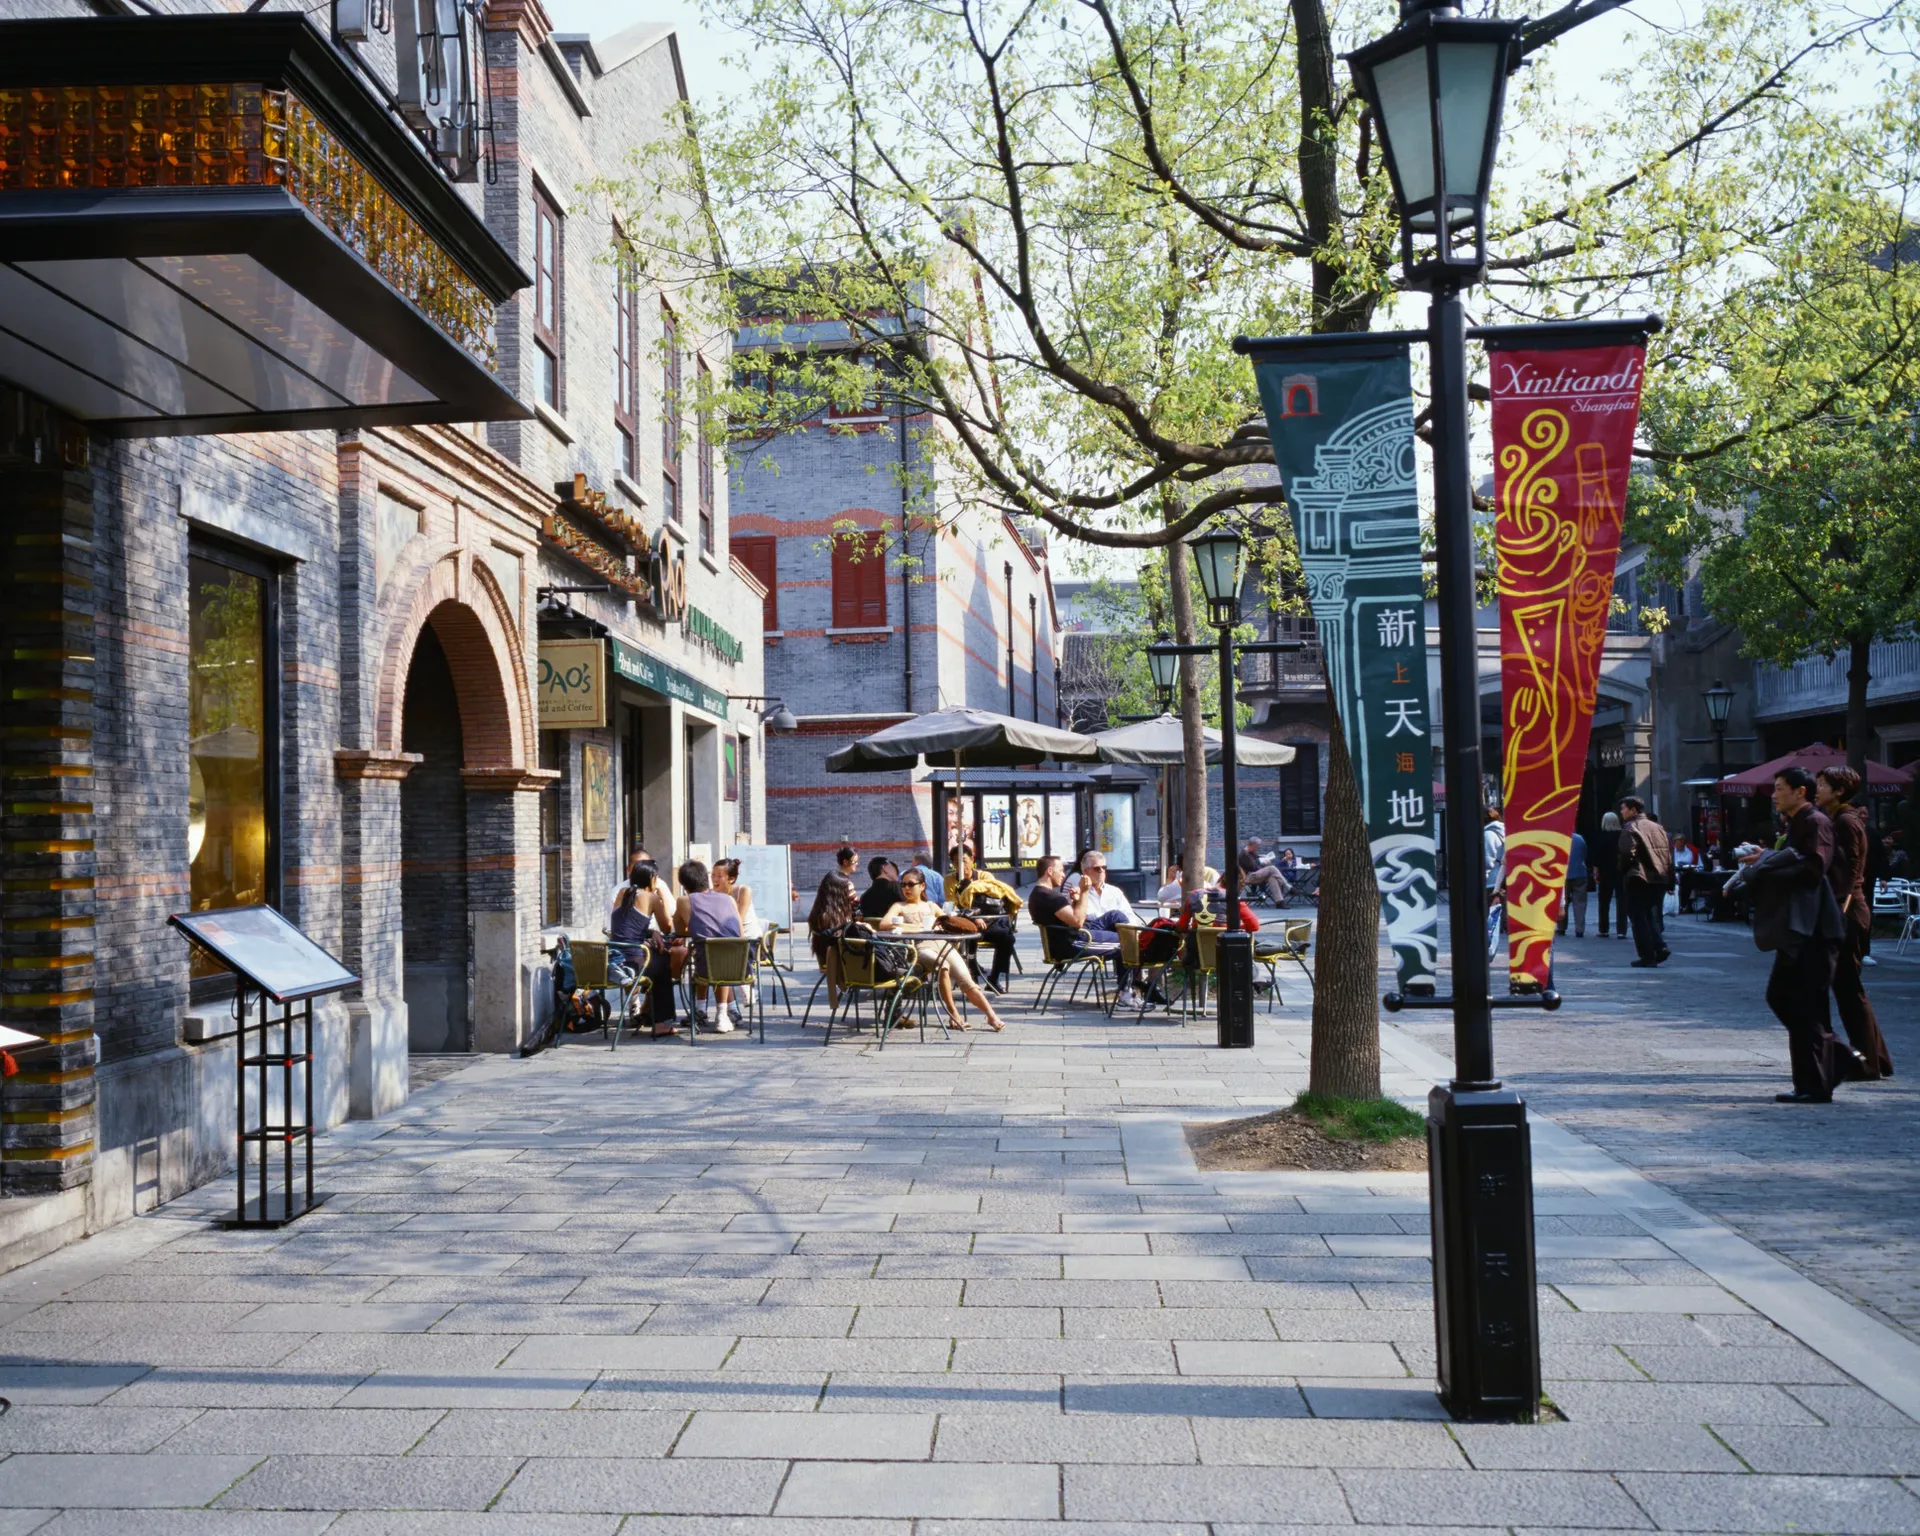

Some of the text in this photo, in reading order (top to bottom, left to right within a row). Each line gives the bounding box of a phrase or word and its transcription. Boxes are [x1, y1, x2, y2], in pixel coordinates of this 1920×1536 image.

[1495, 358, 1642, 394] Xintiandi
[1571, 397, 1637, 416] Shanghai
[552, 703, 566, 712] and
[567, 703, 593, 712] Coffee
